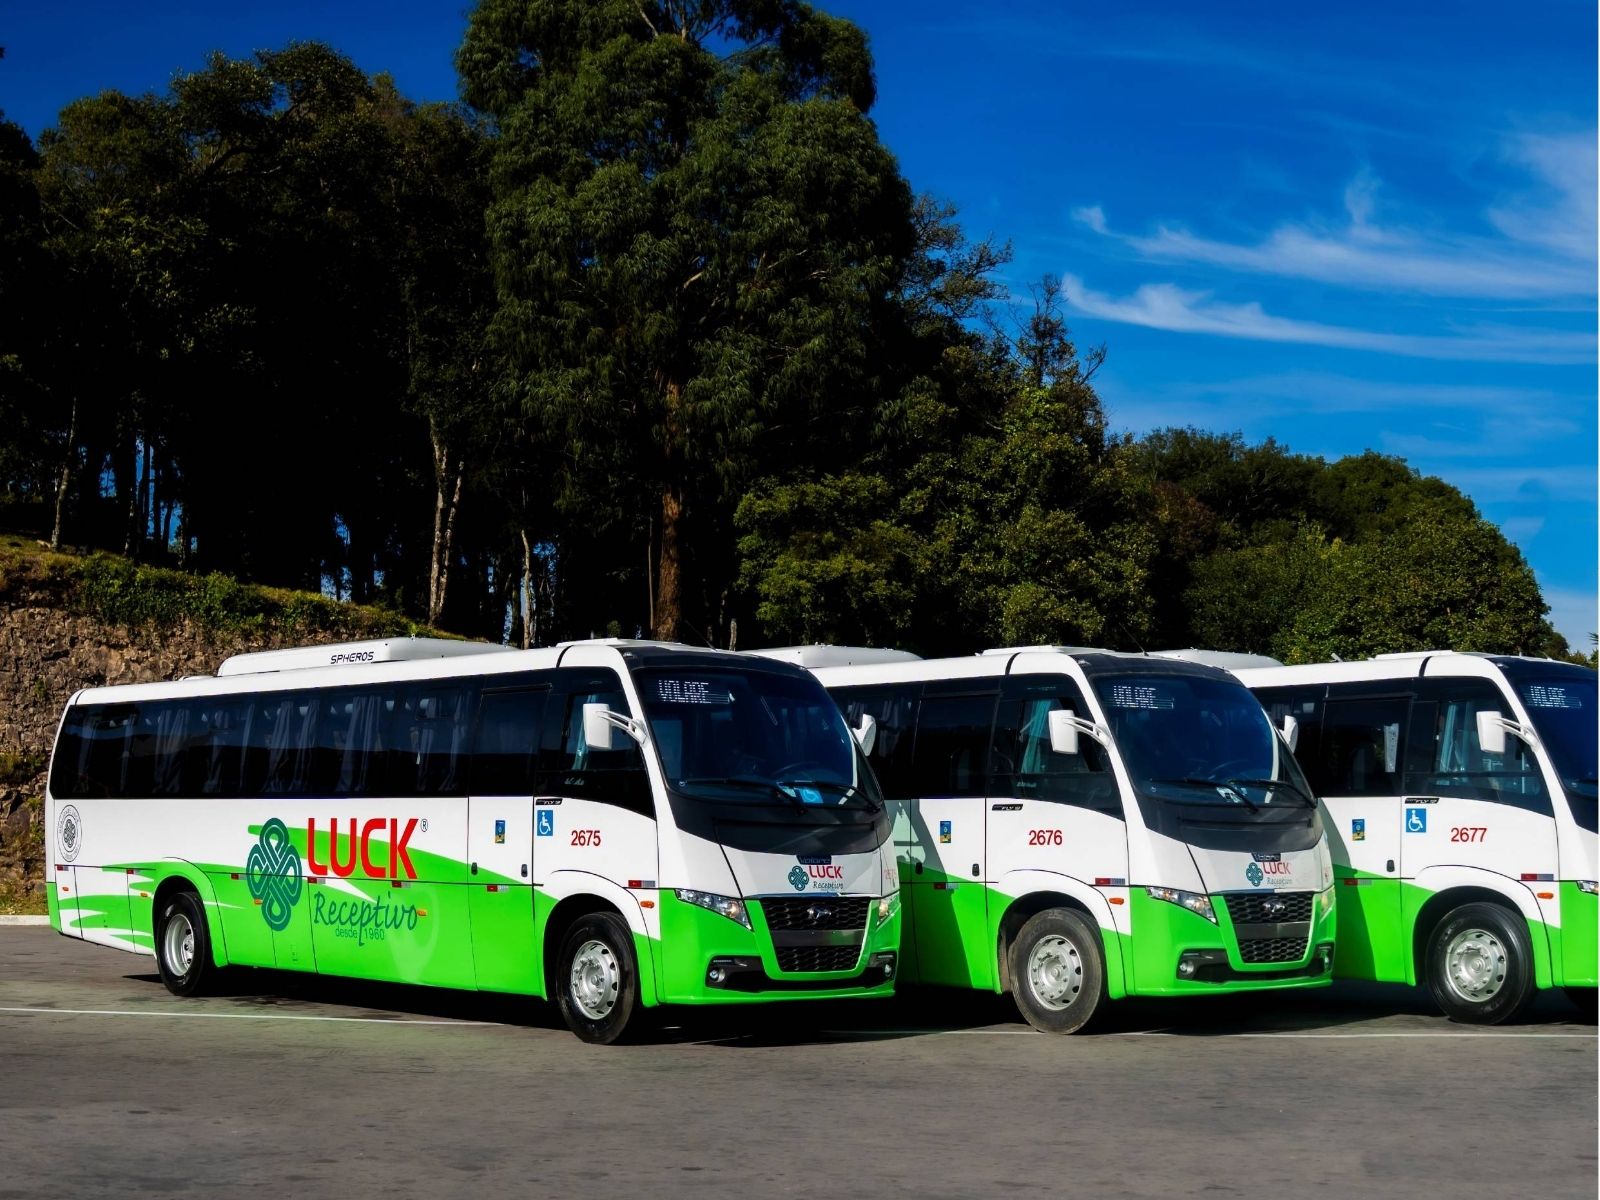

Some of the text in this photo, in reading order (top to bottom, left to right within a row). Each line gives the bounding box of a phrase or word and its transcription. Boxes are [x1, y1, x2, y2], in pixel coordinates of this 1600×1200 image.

[330, 651, 374, 664] SPHEROS
[571, 830, 602, 847] 2675
[1028, 829, 1063, 846] 2676
[1450, 827, 1487, 843] 2677
[307, 818, 419, 880] LUCK
[808, 865, 843, 879] LUCK
[1262, 861, 1292, 875] LUCK
[313, 890, 419, 947] Receptivo
[335, 926, 385, 941] desde 1960
